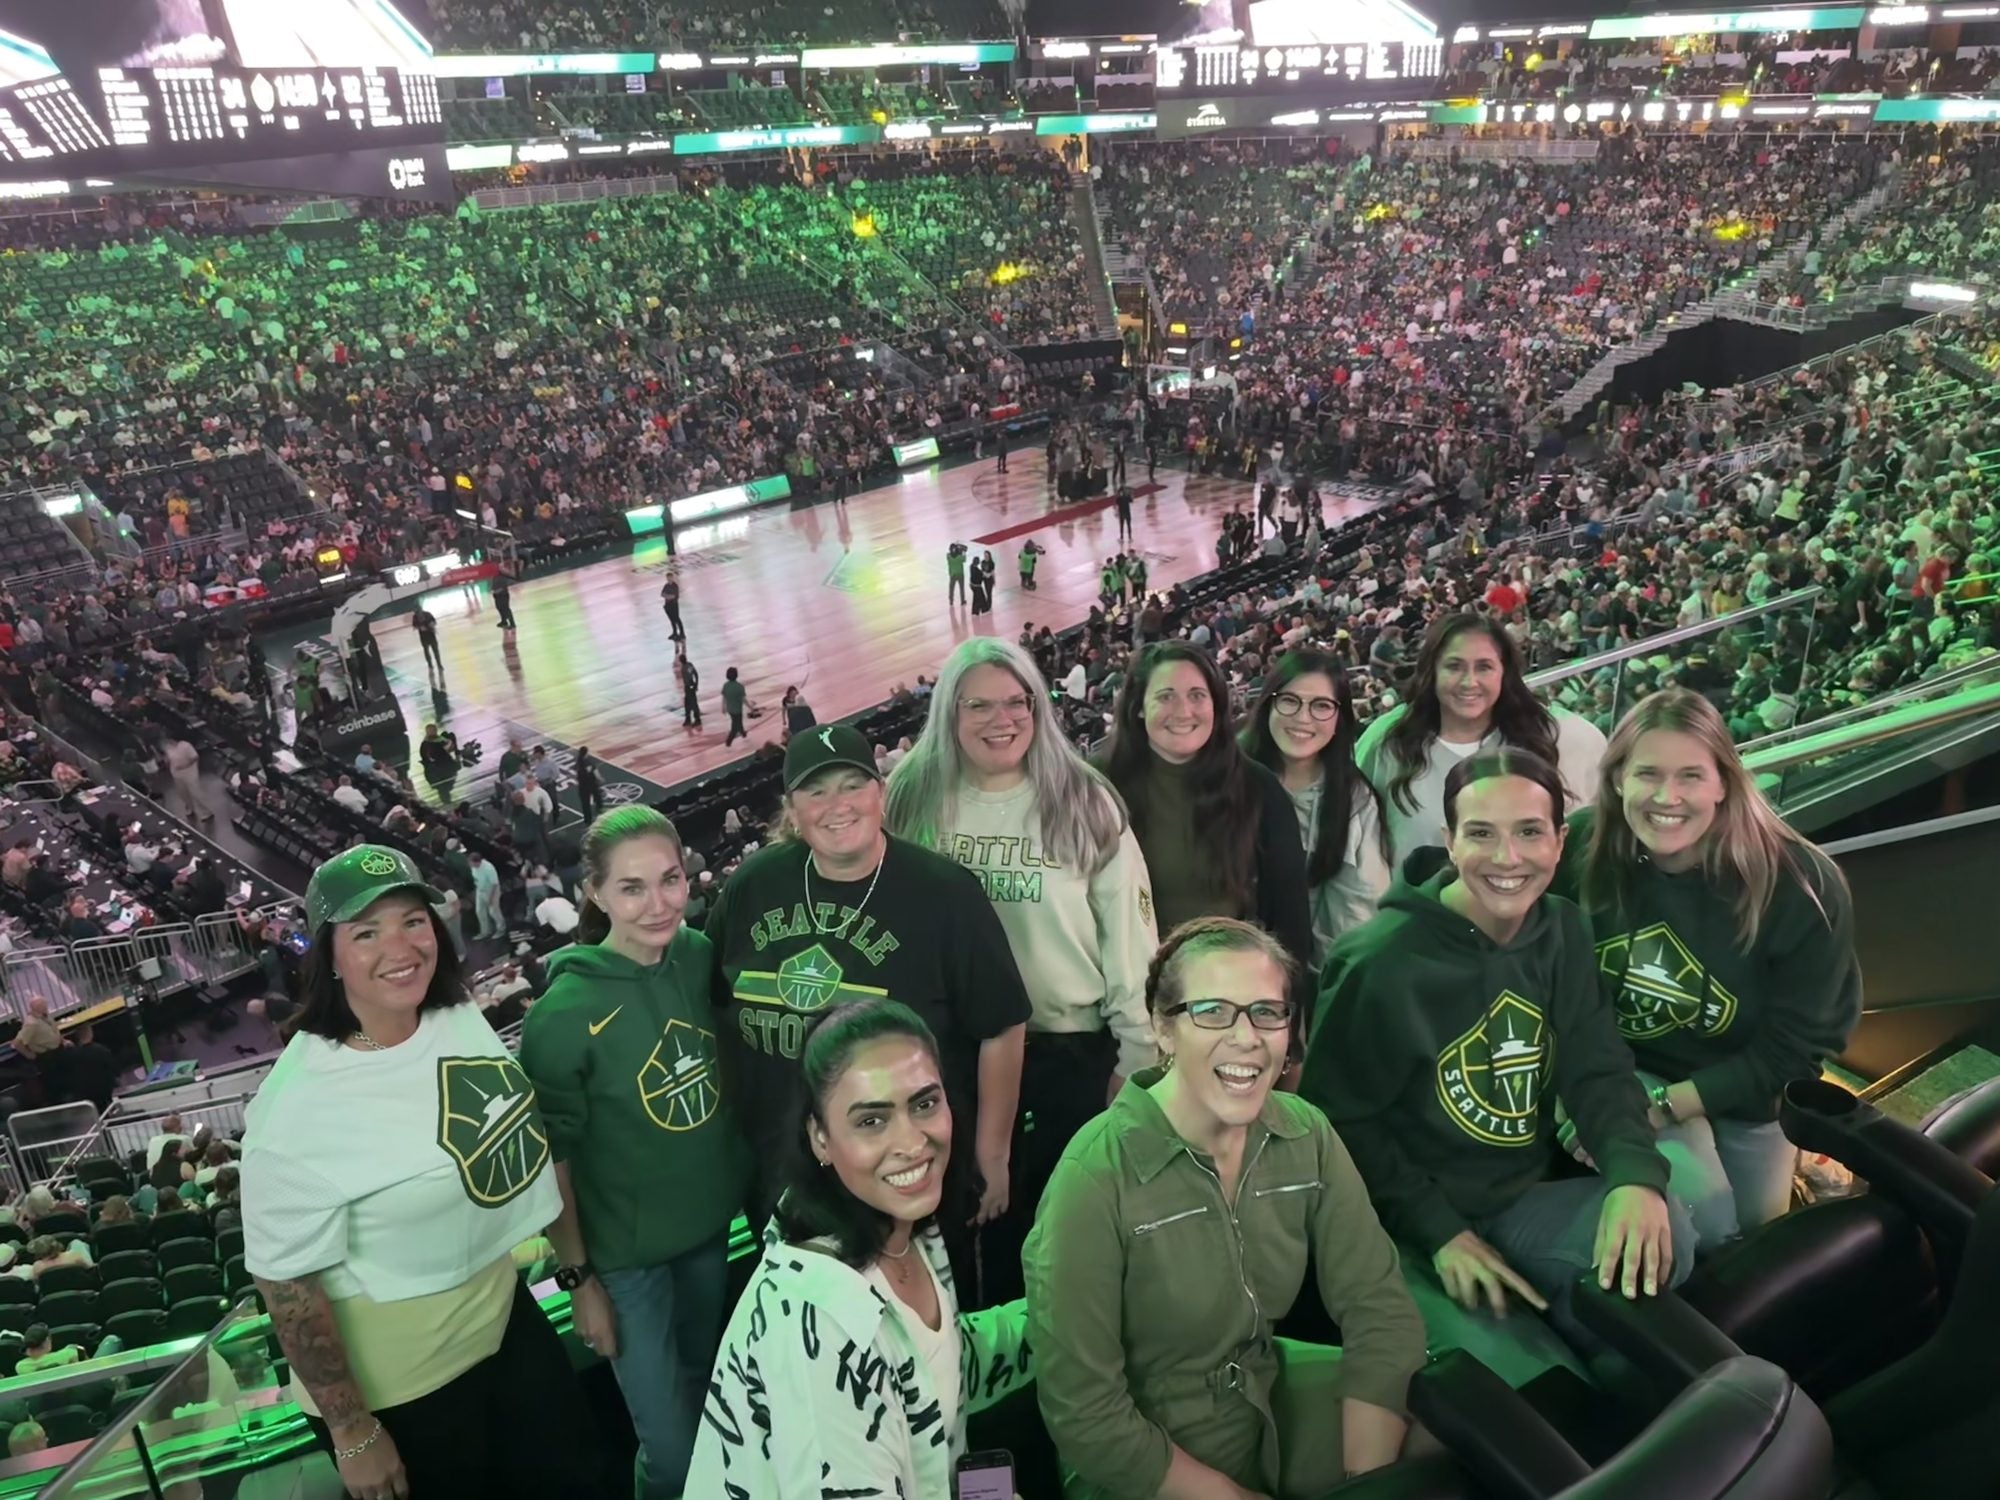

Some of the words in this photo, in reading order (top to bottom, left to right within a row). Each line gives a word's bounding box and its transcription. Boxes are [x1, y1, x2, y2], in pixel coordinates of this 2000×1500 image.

[337, 709, 397, 735] coinbase
[750, 902, 900, 966] SEATTLE
[739, 1007, 814, 1059] STO
[1444, 1069, 1527, 1134] SEATTLE
